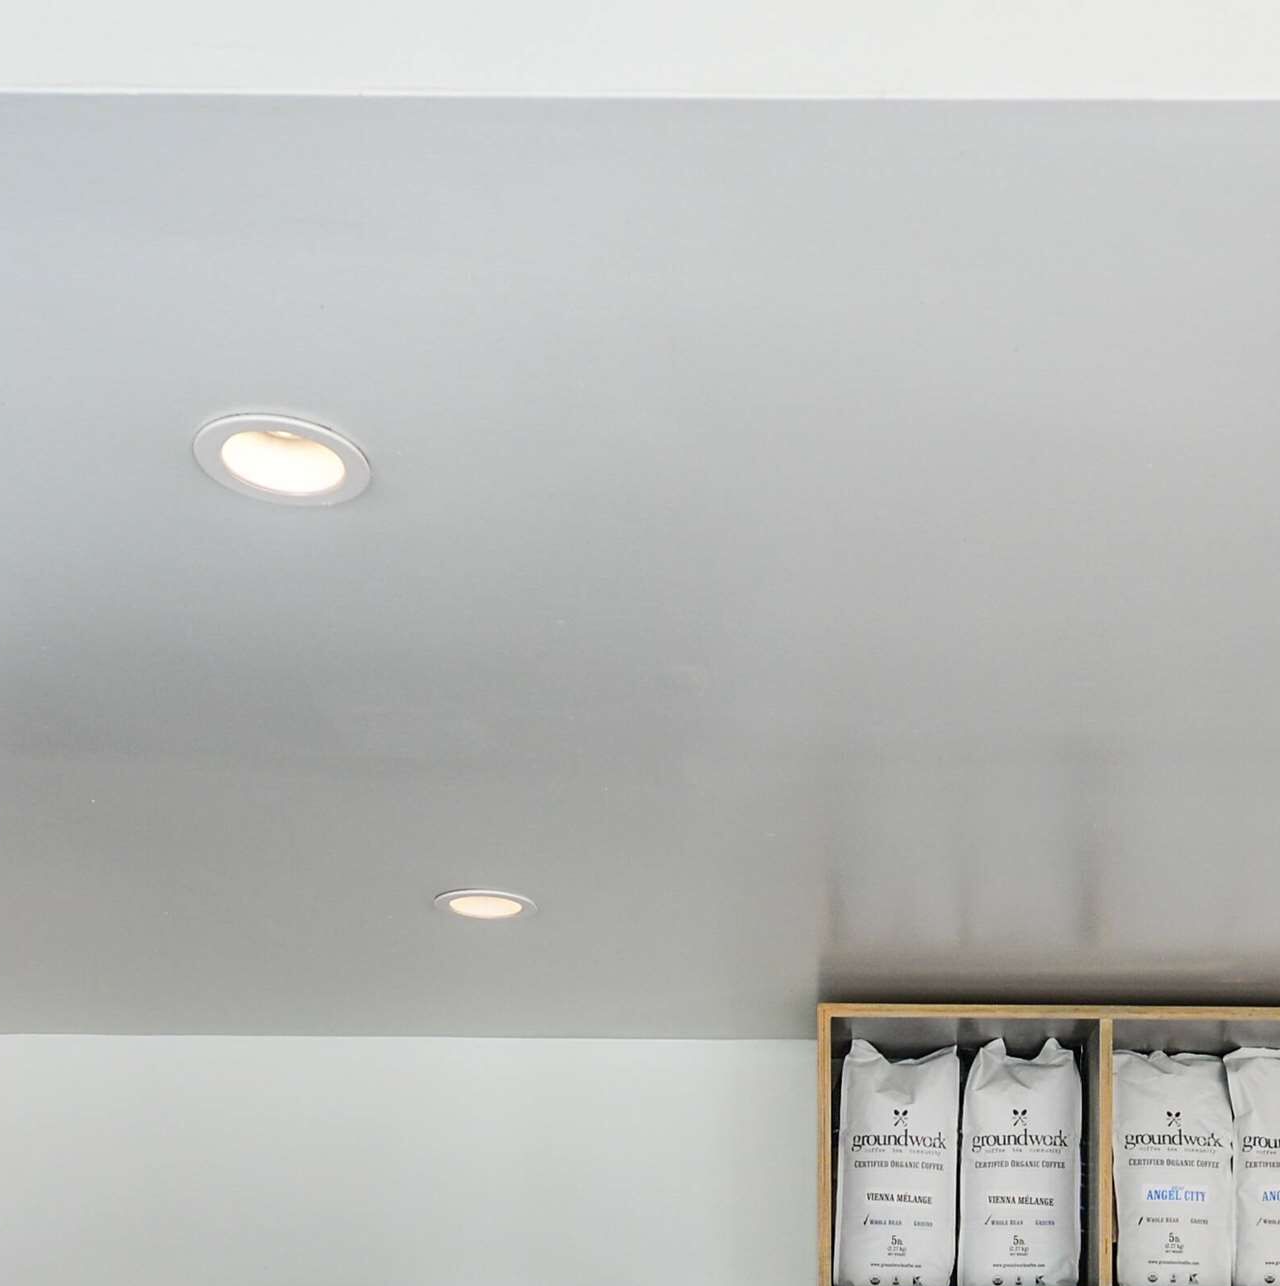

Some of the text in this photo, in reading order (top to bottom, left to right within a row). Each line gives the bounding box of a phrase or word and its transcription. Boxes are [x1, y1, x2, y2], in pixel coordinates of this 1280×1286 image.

[851, 1129, 946, 1152] groundwork
[972, 1128, 1068, 1152] groundwork
[1124, 1128, 1223, 1150] groundwork
[867, 1193, 894, 1201] VIENNA
[988, 1196, 1016, 1204] VIENNA
[1146, 1190, 1206, 1201] ANGEL CITY
